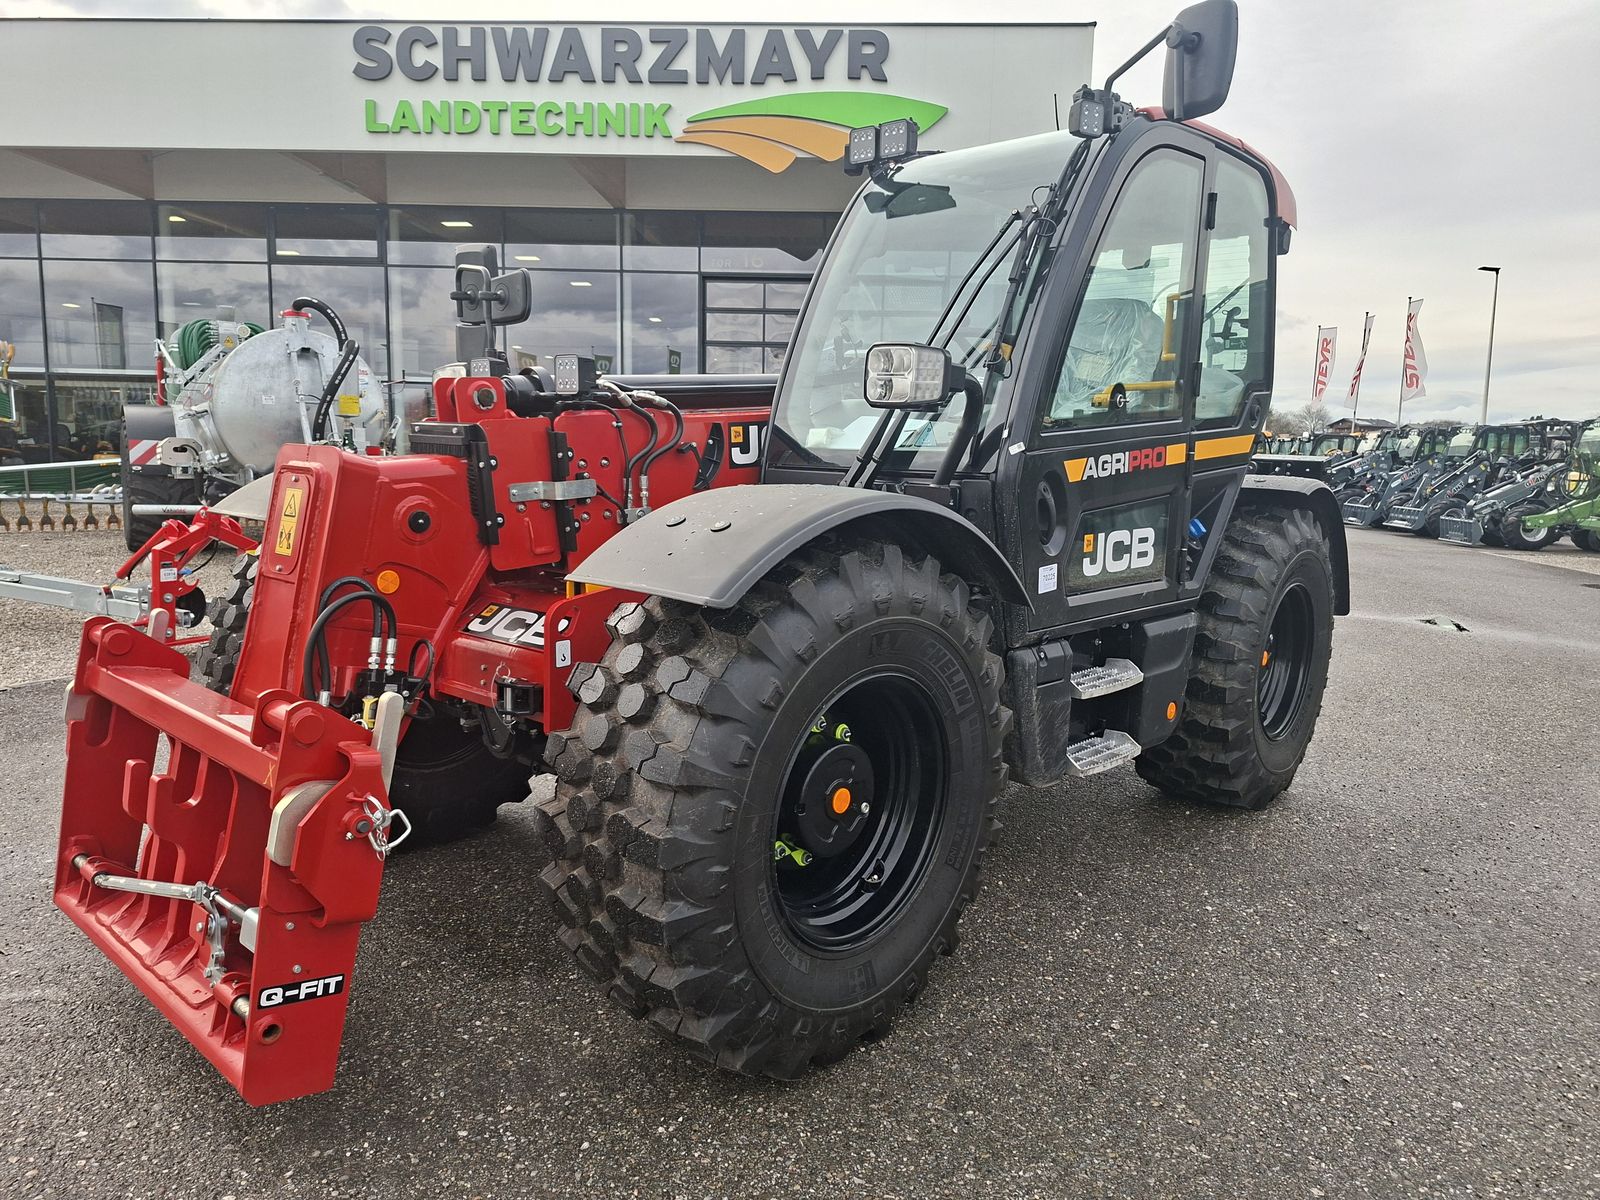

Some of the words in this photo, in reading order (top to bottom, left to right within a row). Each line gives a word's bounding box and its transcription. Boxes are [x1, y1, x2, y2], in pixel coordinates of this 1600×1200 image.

[353, 25, 891, 85] SCHWARZMAYR
[365, 98, 673, 137] LANDTECHNIK
[731, 425, 767, 466] J
[1082, 446, 1166, 480] AGRIPRO
[1082, 527, 1156, 577] JCB
[260, 975, 343, 1007] Q-FIT
